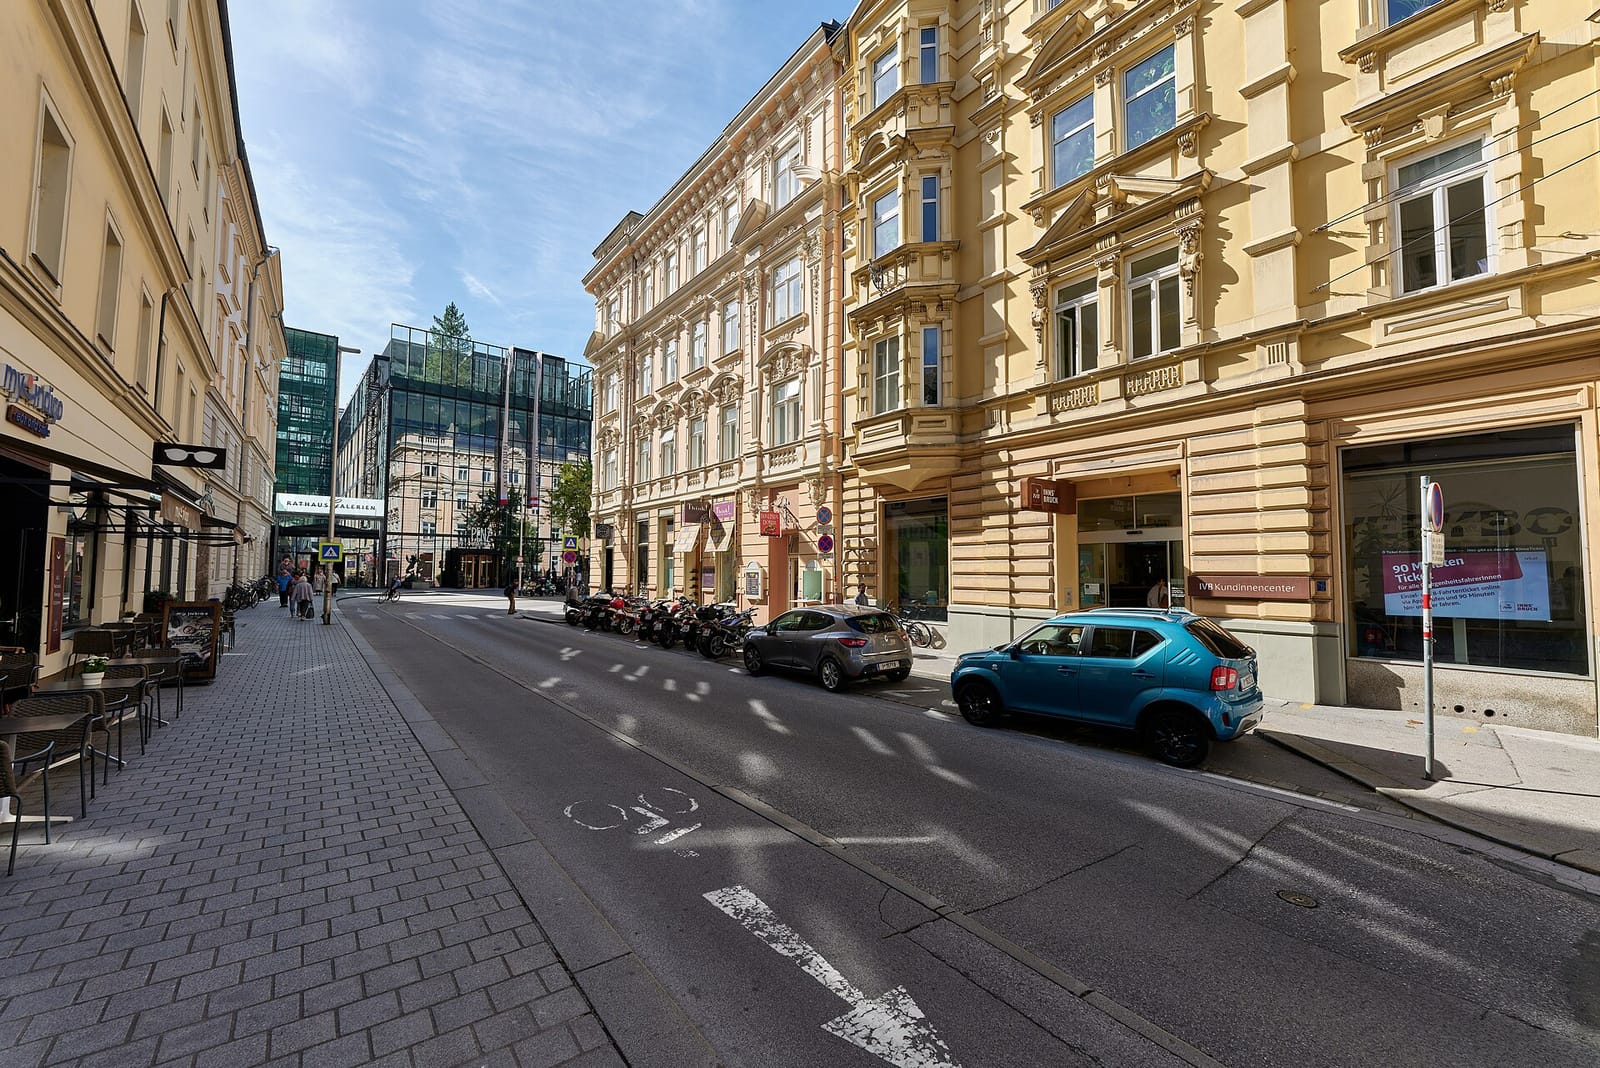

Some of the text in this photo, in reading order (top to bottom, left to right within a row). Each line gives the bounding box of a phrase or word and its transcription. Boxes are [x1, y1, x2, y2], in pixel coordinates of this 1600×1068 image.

[286, 500, 329, 508] RATHAUS
[1043, 495, 1059, 504] BRUCK
[1392, 557, 1465, 574] 90 Mten
[1394, 572, 1432, 583] Tick
[1199, 582, 1214, 591] IVB
[1469, 591, 1496, 599] Minuten
